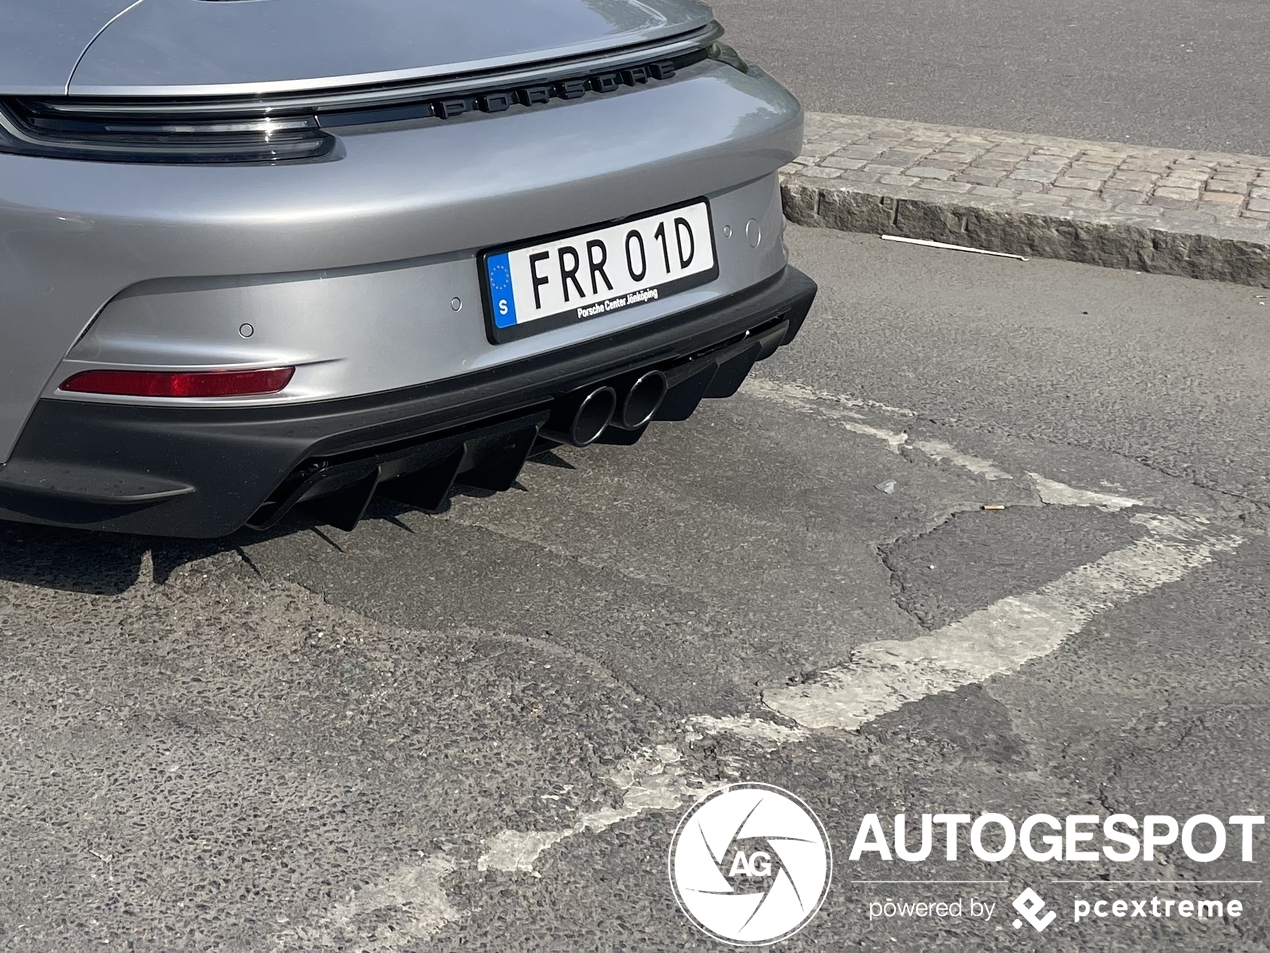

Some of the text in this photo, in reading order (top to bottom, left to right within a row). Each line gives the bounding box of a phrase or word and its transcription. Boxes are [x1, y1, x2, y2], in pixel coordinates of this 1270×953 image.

[433, 61, 676, 120] PORSCHE
[528, 216, 695, 310] FRR 01D
[498, 299, 509, 315] S
[577, 288, 659, 319] Porsche Center Jönköping
